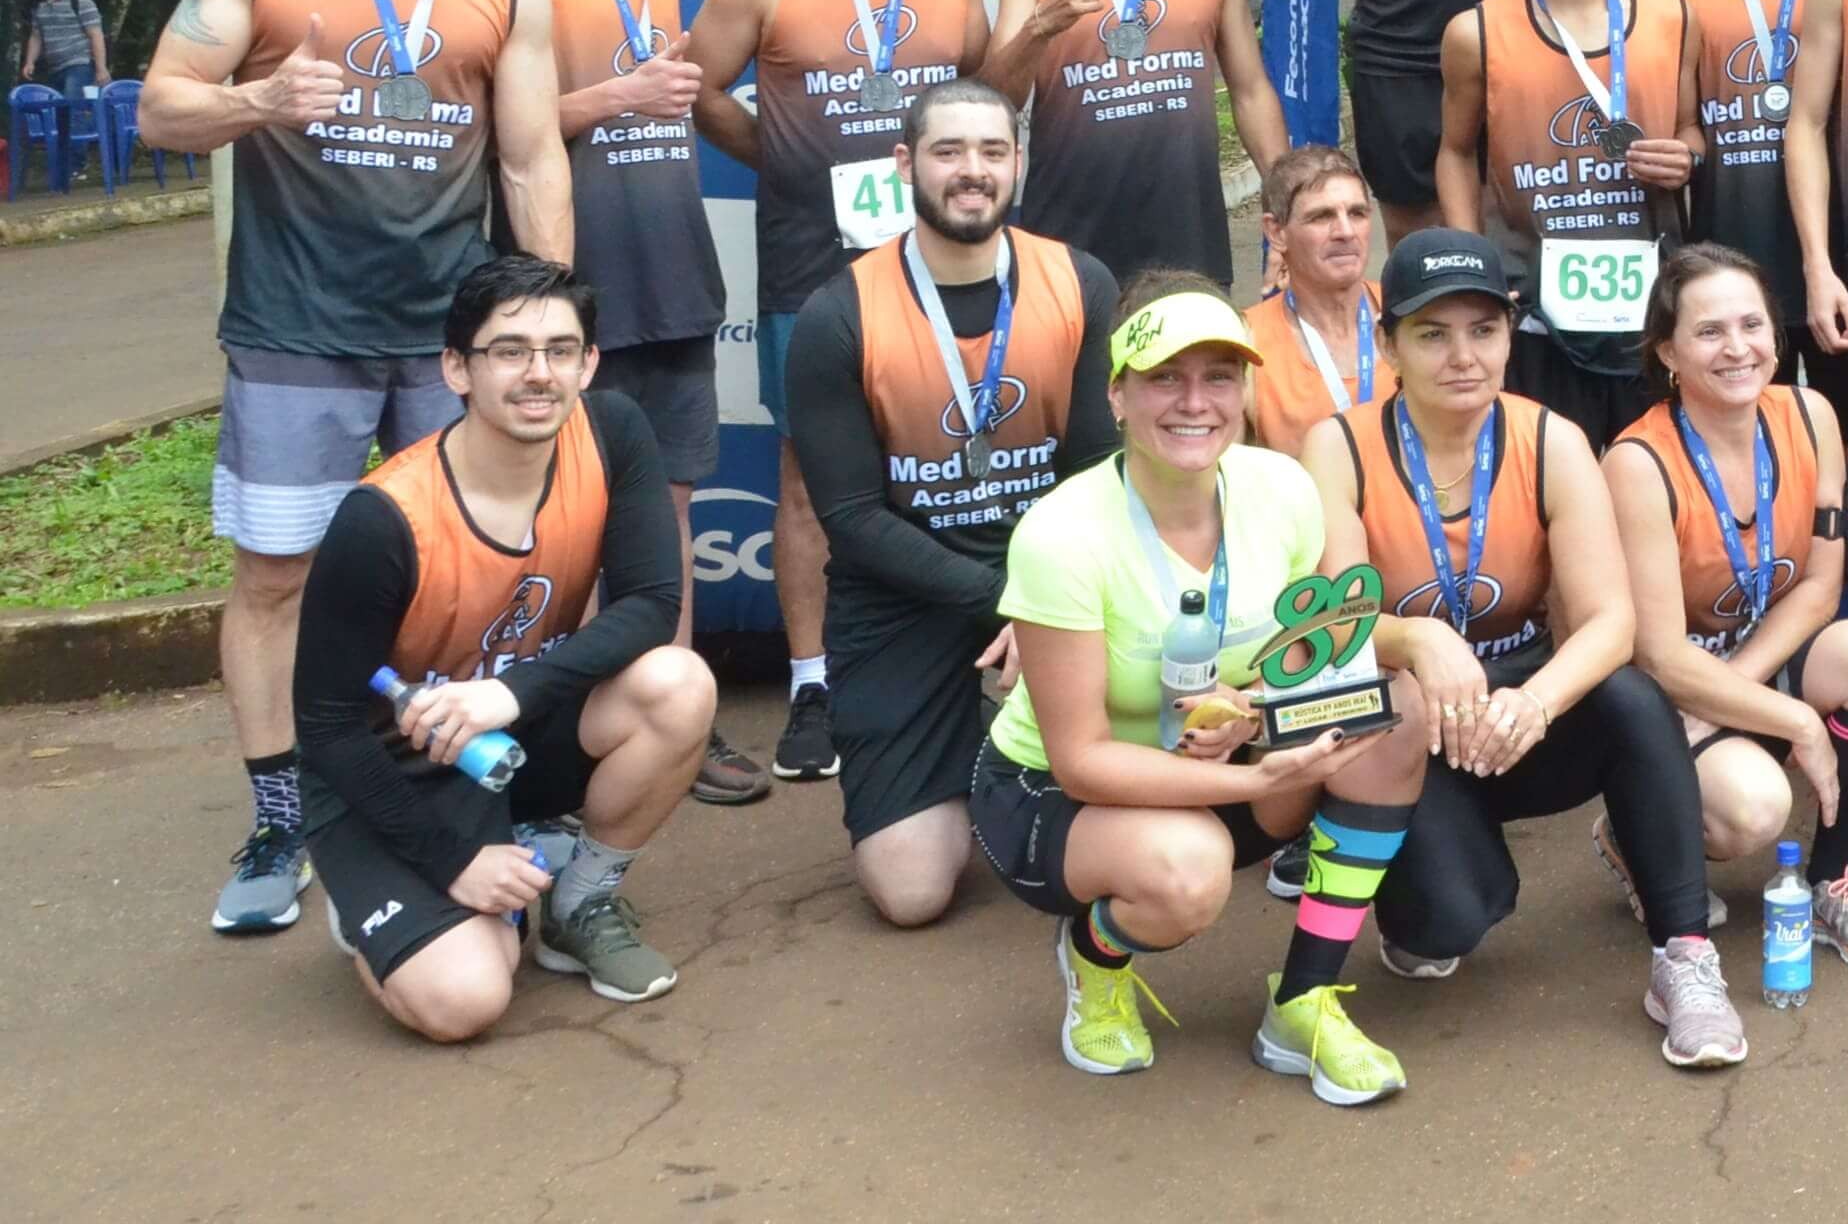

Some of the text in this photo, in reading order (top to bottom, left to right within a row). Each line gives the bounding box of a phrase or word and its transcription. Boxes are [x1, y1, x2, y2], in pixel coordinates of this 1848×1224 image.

[804, 63, 959, 95] Med orma
[1062, 50, 1206, 89] Med Forma
[1082, 74, 1193, 106] Academia
[1094, 96, 1188, 123] SEBERI RS
[1701, 96, 1744, 128] Med
[306, 121, 455, 150] Academia
[590, 122, 687, 146] Academi
[839, 117, 903, 136] SEBERI
[321, 147, 438, 171] SEBERI RS
[1722, 149, 1778, 167] SEBERI
[1513, 157, 1633, 190] Med For
[1532, 187, 1646, 212] Academia
[1545, 211, 1640, 233] SEBERI RS
[1557, 251, 1645, 302] 635
[888, 453, 963, 484] Med
[910, 470, 1058, 509] Academia
[929, 507, 1004, 531] SEBERI
[361, 899, 404, 937] FILA
